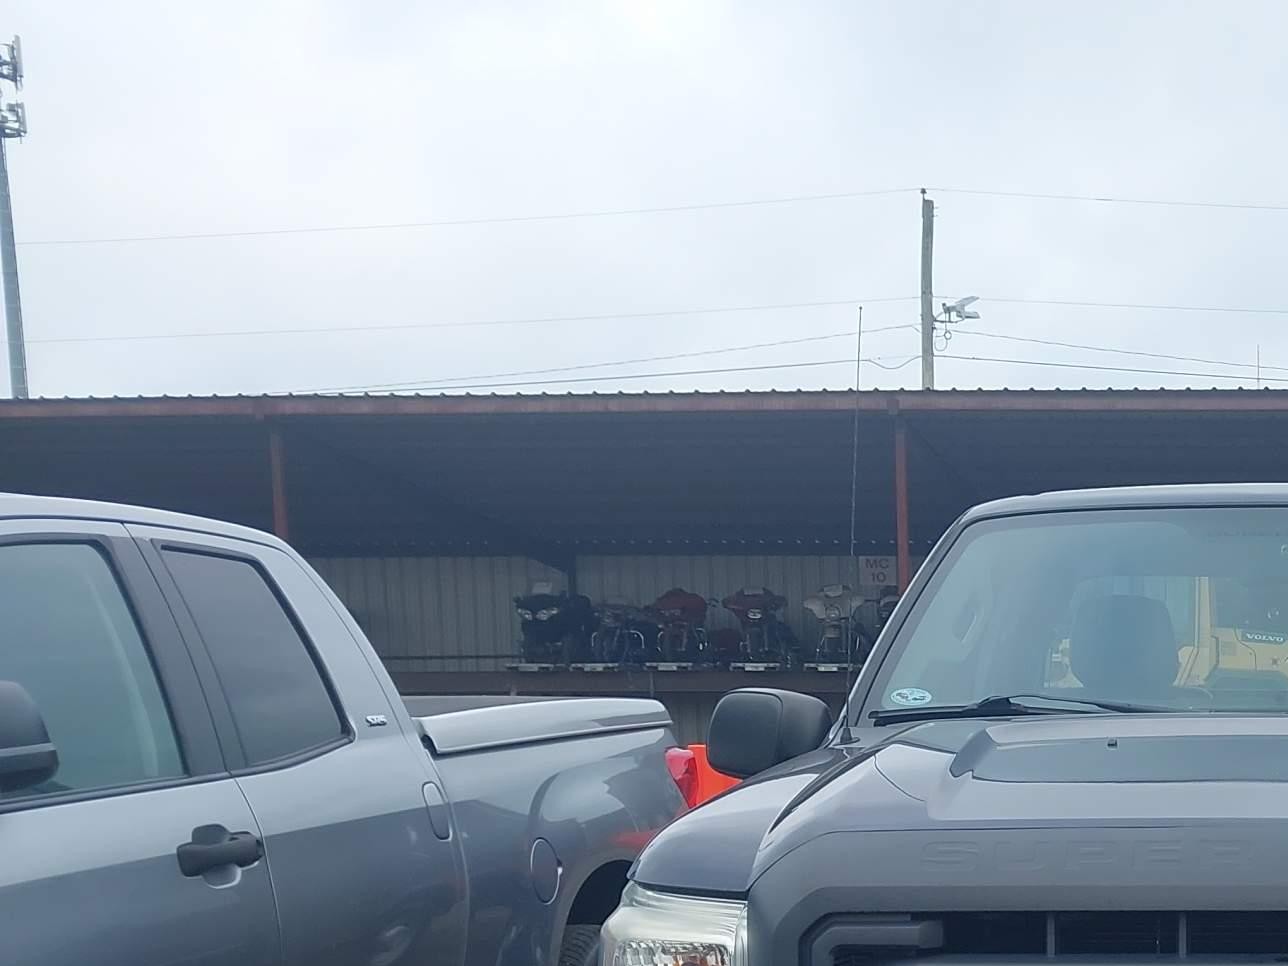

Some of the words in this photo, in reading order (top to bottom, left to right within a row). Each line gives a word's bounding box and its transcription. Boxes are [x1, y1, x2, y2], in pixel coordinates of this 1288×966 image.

[865, 559, 889, 569] MC
[872, 571, 887, 583] 10
[1246, 633, 1284, 642] VOLVO
[920, 840, 1255, 872] SUPER
